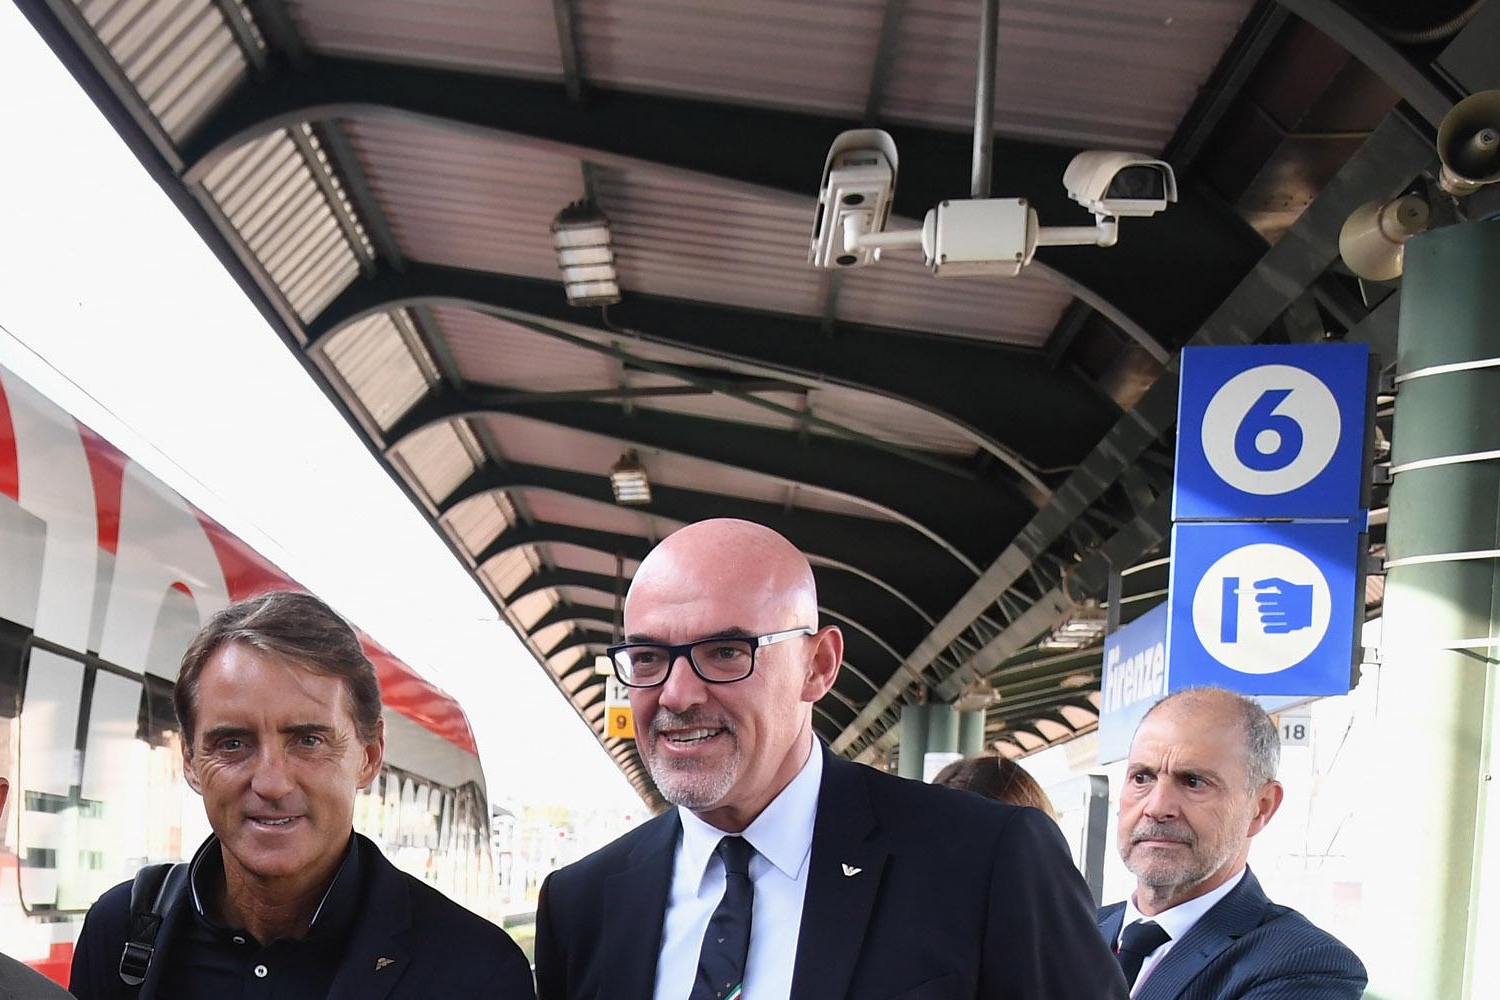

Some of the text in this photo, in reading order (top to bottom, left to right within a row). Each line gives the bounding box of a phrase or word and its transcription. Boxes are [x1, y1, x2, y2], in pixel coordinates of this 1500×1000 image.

[1234, 388, 1304, 472] 6
[1105, 641, 1164, 714] Firenze
[616, 714, 627, 729] 9
[1283, 724, 1306, 740] 18
